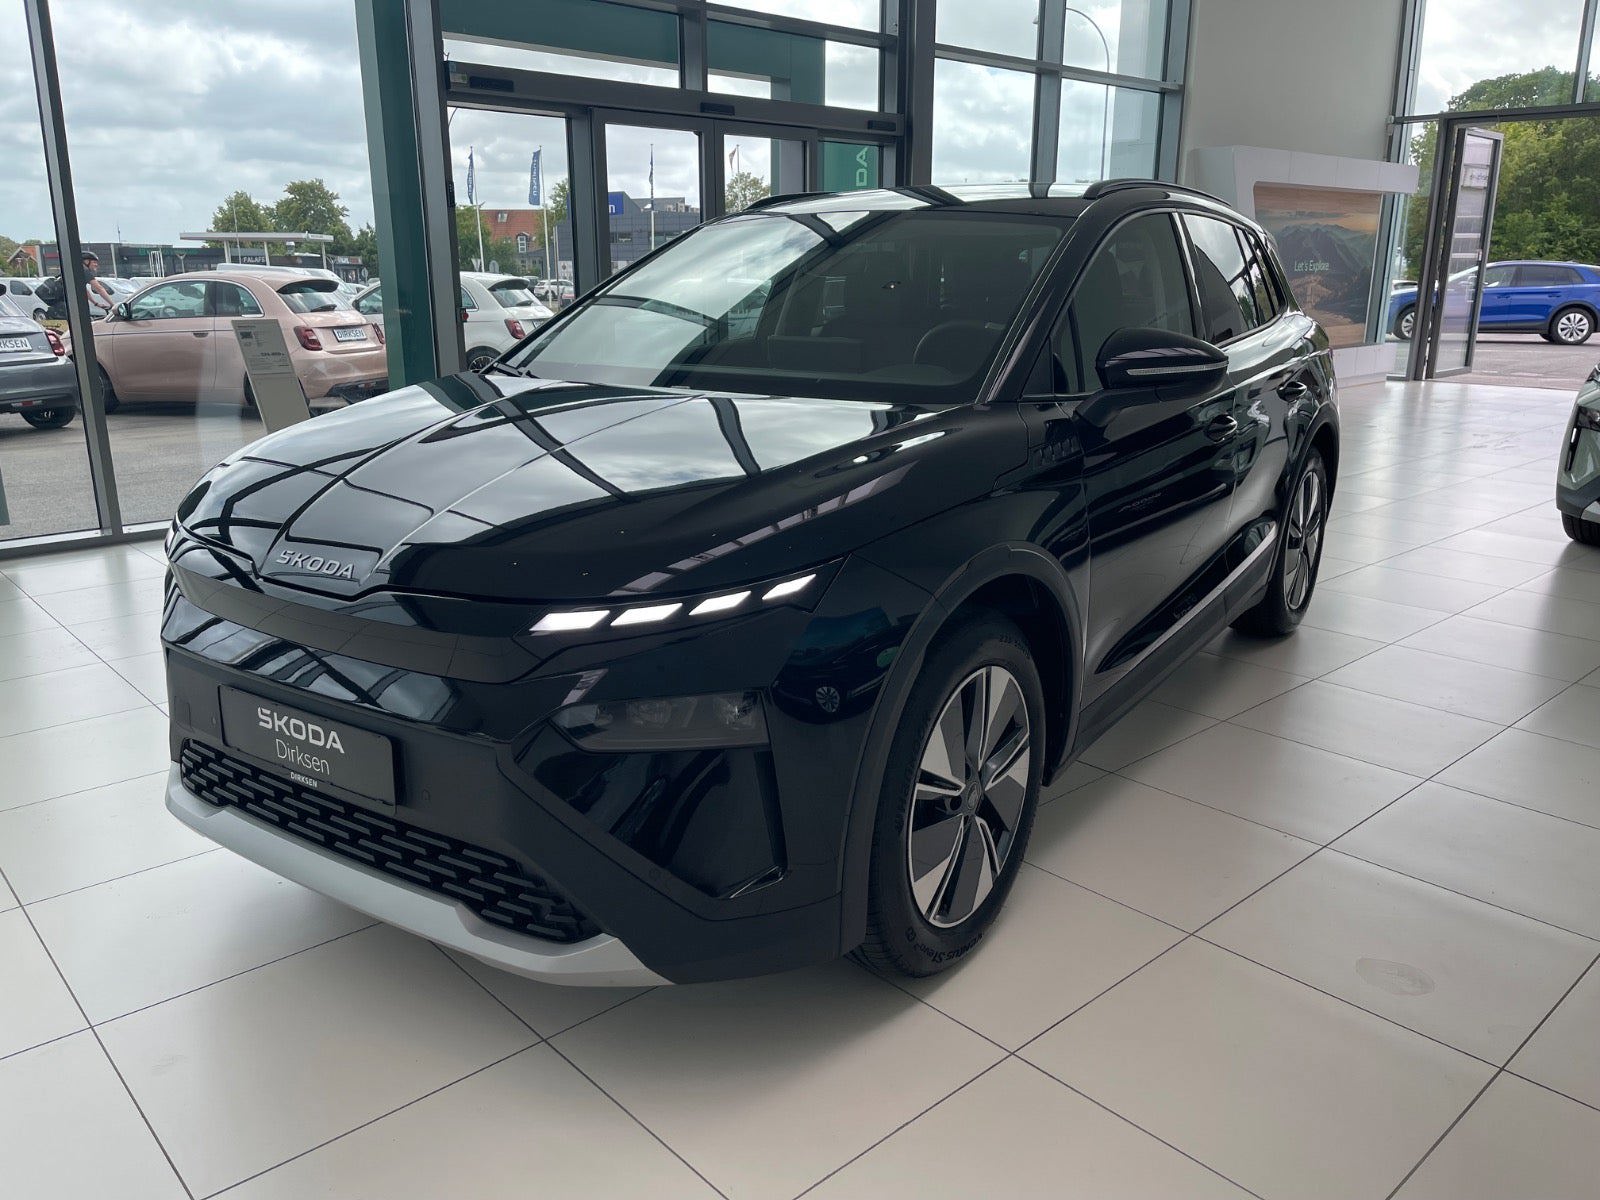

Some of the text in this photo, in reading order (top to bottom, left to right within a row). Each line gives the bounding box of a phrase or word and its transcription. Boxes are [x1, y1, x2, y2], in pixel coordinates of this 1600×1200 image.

[1308, 259, 1330, 273] Explore
[336, 328, 365, 339] DIRKSEN
[275, 738, 330, 775] Dirksen
[290, 771, 318, 788] DIRKSEN
